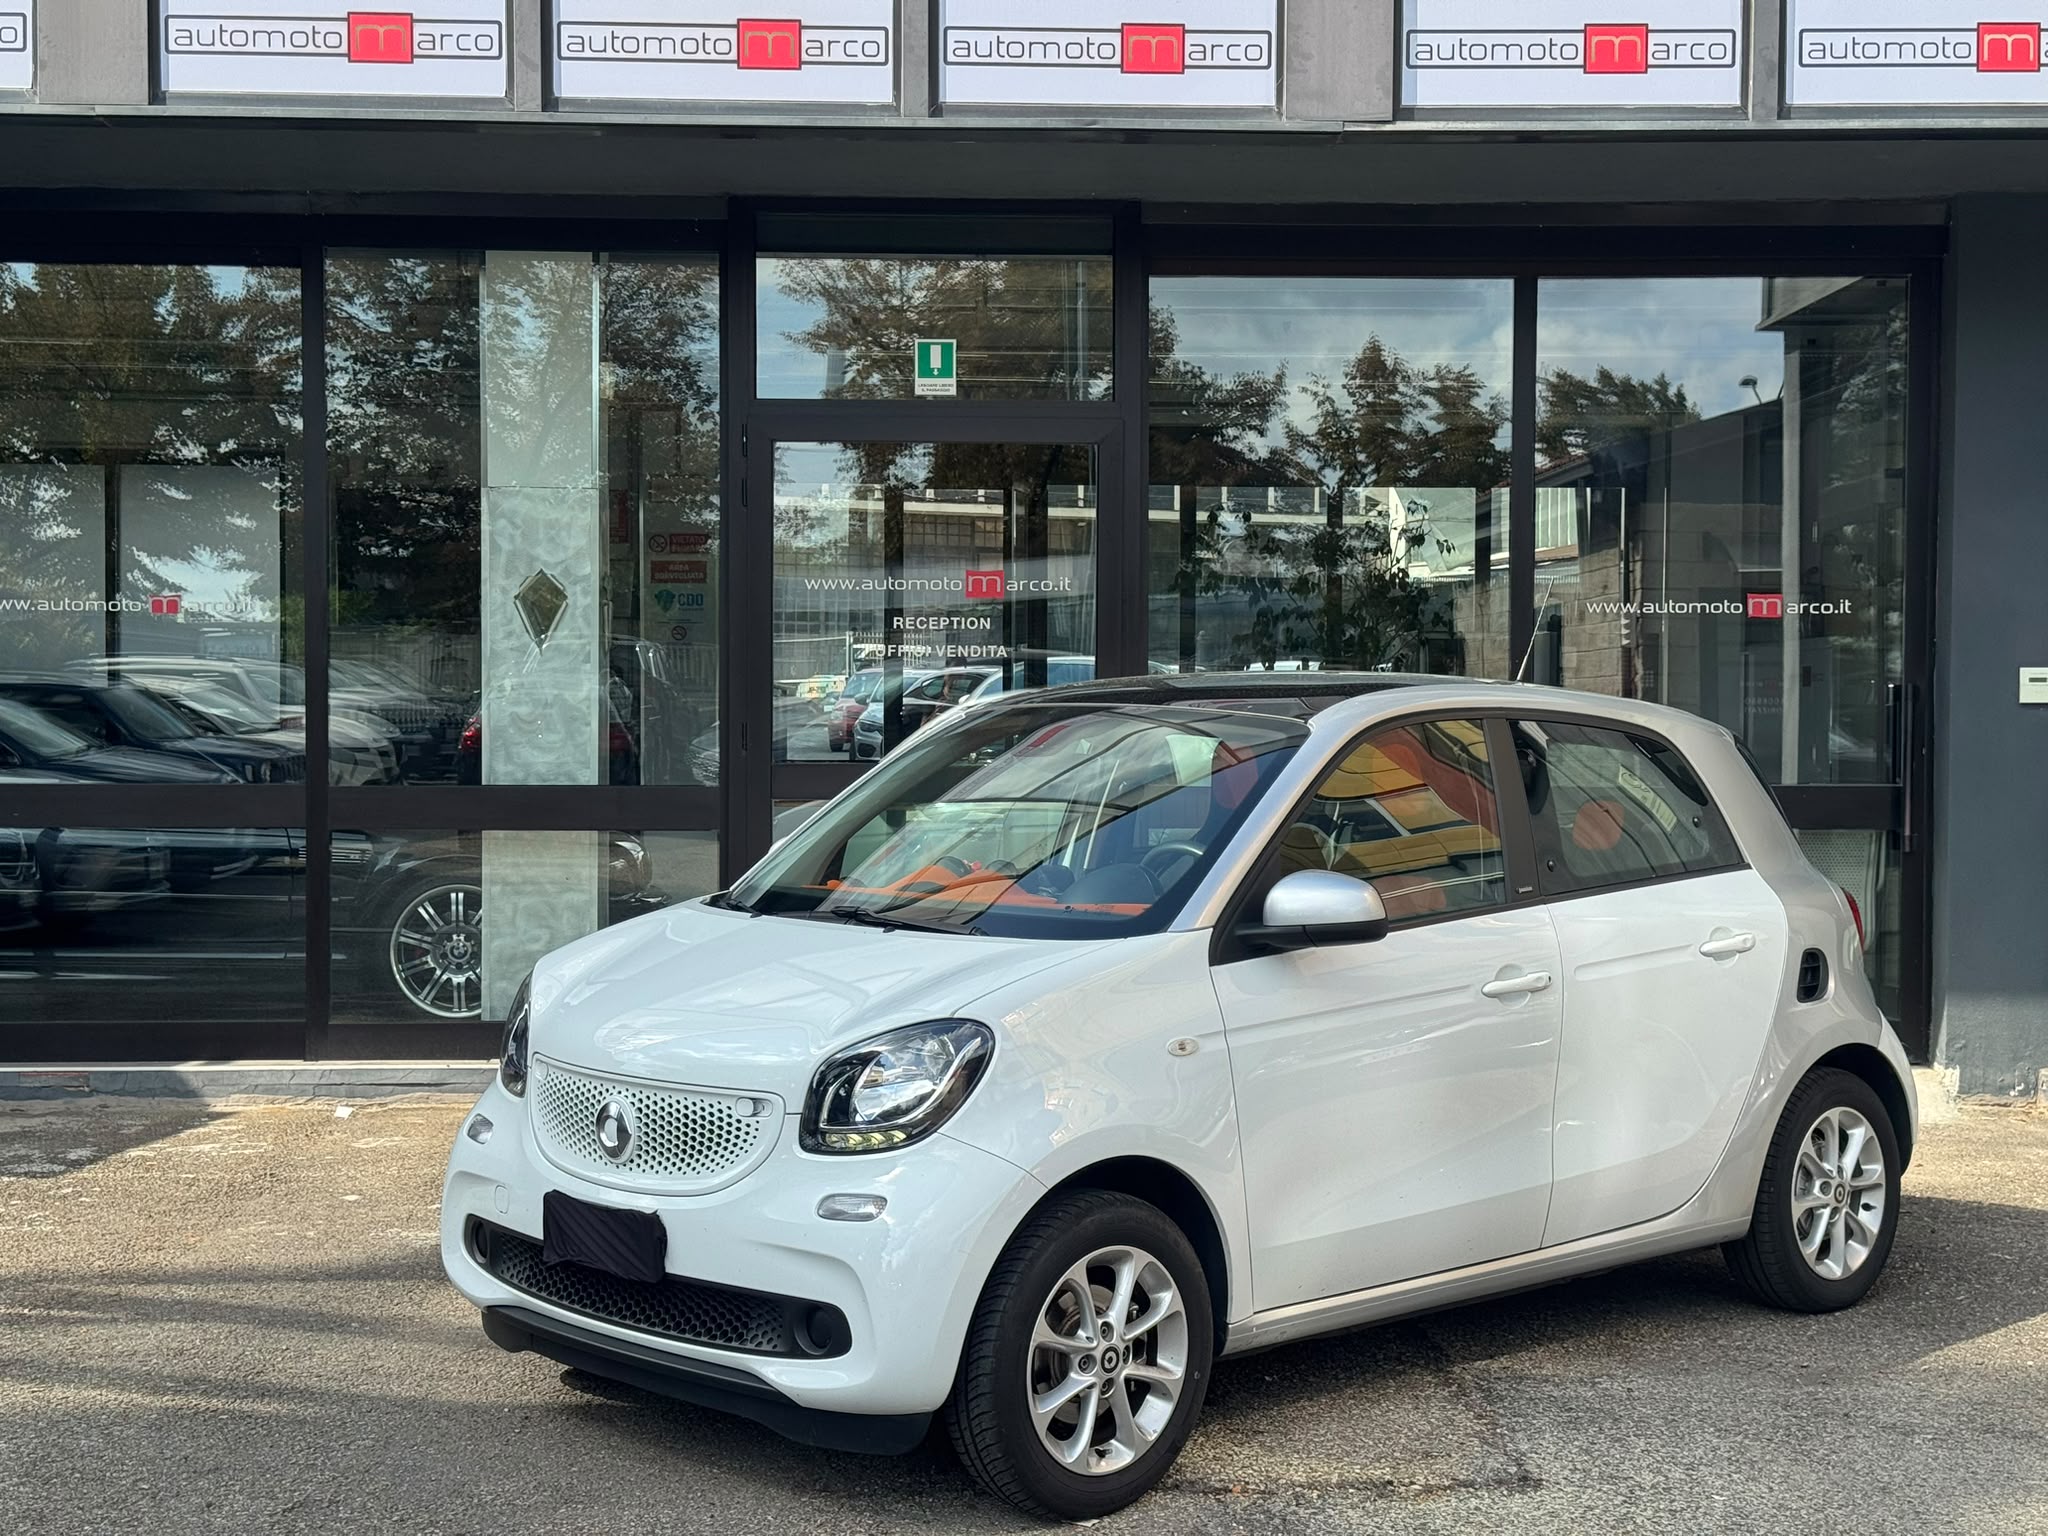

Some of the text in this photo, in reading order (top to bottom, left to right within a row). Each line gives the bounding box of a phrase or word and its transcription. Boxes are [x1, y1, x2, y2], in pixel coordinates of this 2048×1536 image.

[804, 575, 1072, 592] www.automotomarco.it
[1586, 598, 1852, 614] www.automotomarco.it
[893, 616, 991, 630] RECEPTION
[935, 645, 1008, 658] VENDITA
